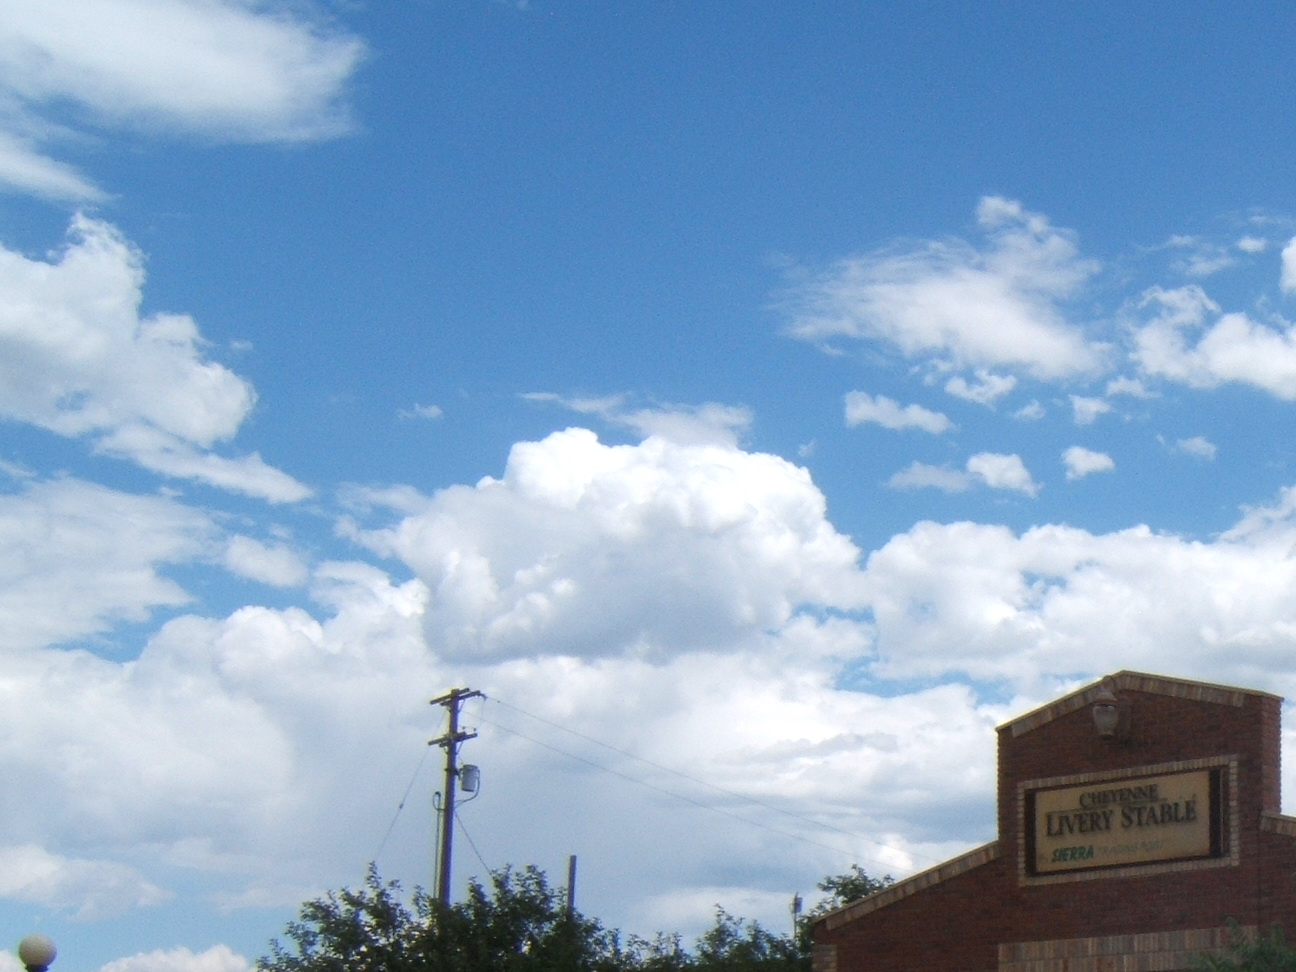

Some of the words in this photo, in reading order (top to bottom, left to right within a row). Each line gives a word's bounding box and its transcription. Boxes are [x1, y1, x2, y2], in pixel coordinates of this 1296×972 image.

[1079, 784, 1159, 809] CHEYENNE
[1046, 810, 1113, 837] LIVERY
[1120, 799, 1197, 829] STABLE
[1051, 845, 1095, 863] SIERRA
